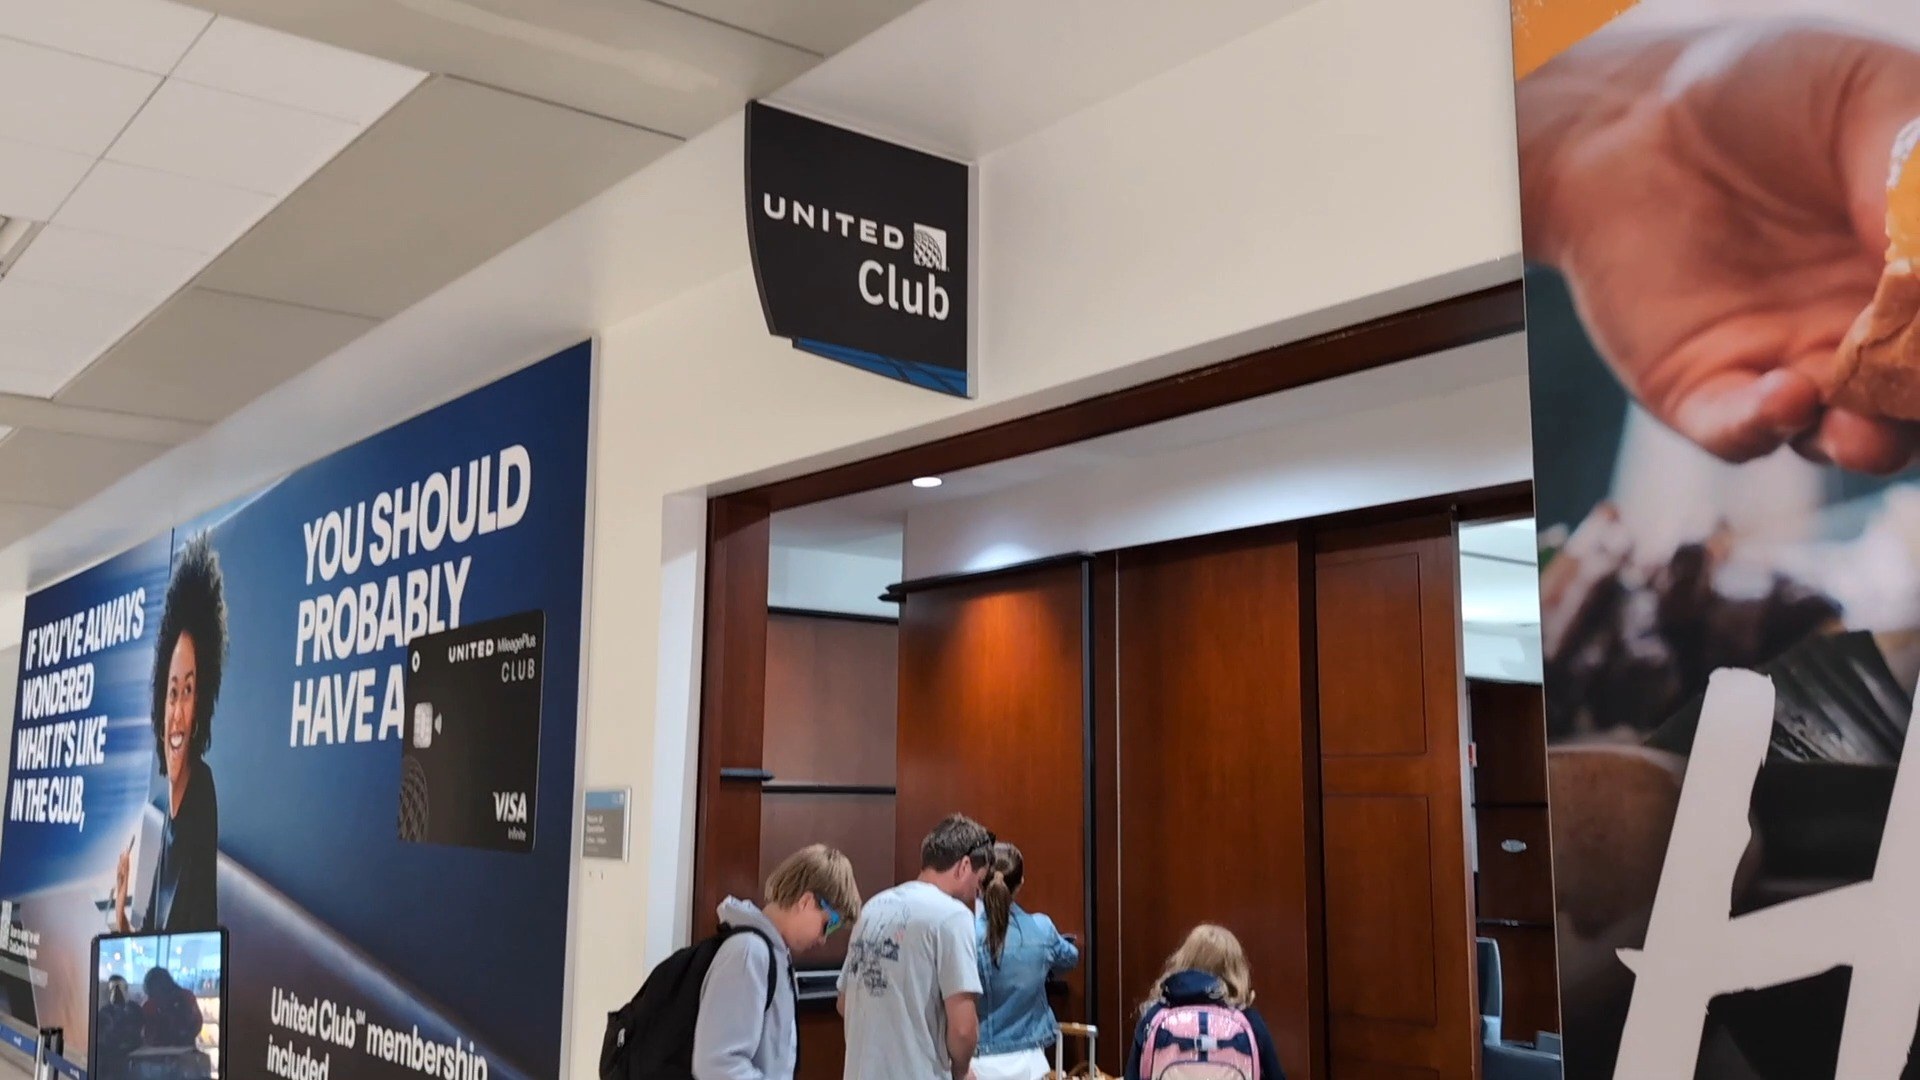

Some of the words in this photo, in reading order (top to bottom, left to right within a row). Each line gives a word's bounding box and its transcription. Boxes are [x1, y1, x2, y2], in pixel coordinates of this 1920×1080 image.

[764, 193, 904, 250] UNITED
[858, 259, 950, 321] Club
[303, 501, 366, 586] YOU
[369, 444, 531, 567] SHOULD
[25, 628, 38, 671] IF
[38, 611, 85, 668] YOU'VE
[83, 587, 145, 655] ALWAYS
[295, 556, 472, 667] PROBABLY
[448, 638, 494, 664] UNITED
[501, 658, 535, 683] CLUB
[22, 662, 94, 720] WONDERED
[290, 668, 376, 748] HAVE
[378, 664, 405, 741] A
[17, 724, 54, 770] WHAT
[51, 720, 76, 768] IT'S
[75, 715, 108, 766] LIKE
[10, 778, 26, 821] IN
[25, 777, 49, 822] THE
[48, 775, 85, 832] CLUB,
[492, 791, 527, 824] VISA
[267, 1034, 330, 1080] included
[270, 986, 318, 1037] United
[366, 1024, 488, 1080] membership
